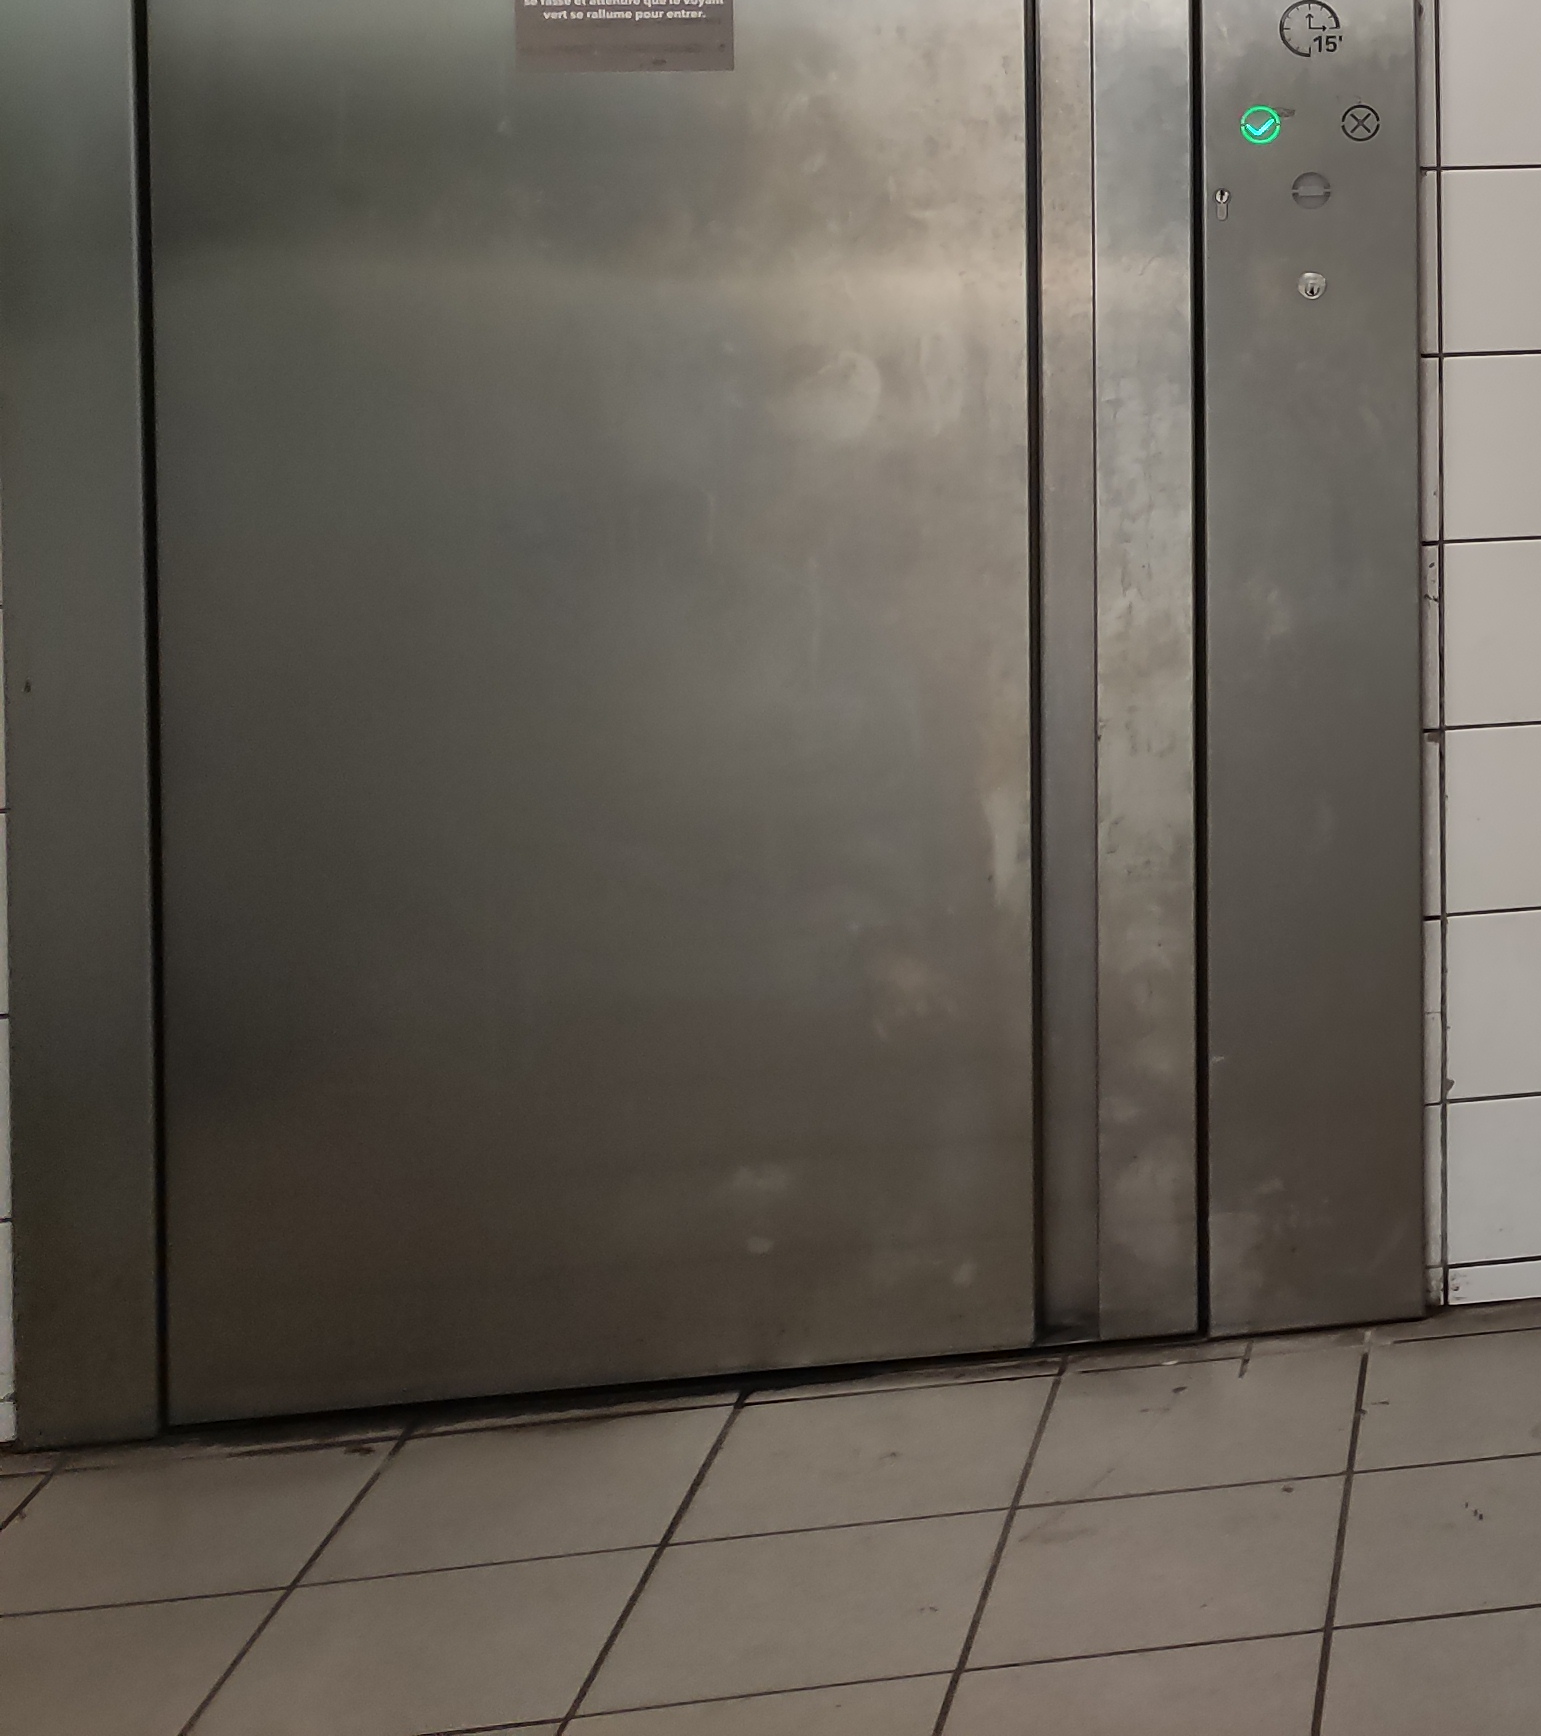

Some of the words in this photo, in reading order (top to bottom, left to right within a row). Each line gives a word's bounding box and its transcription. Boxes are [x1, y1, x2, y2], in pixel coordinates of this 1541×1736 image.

[543, 10, 568, 20] vert
[570, 10, 584, 20] se
[586, 8, 633, 19] rallume
[635, 10, 665, 22] pour
[666, 9, 707, 19] entrer.
